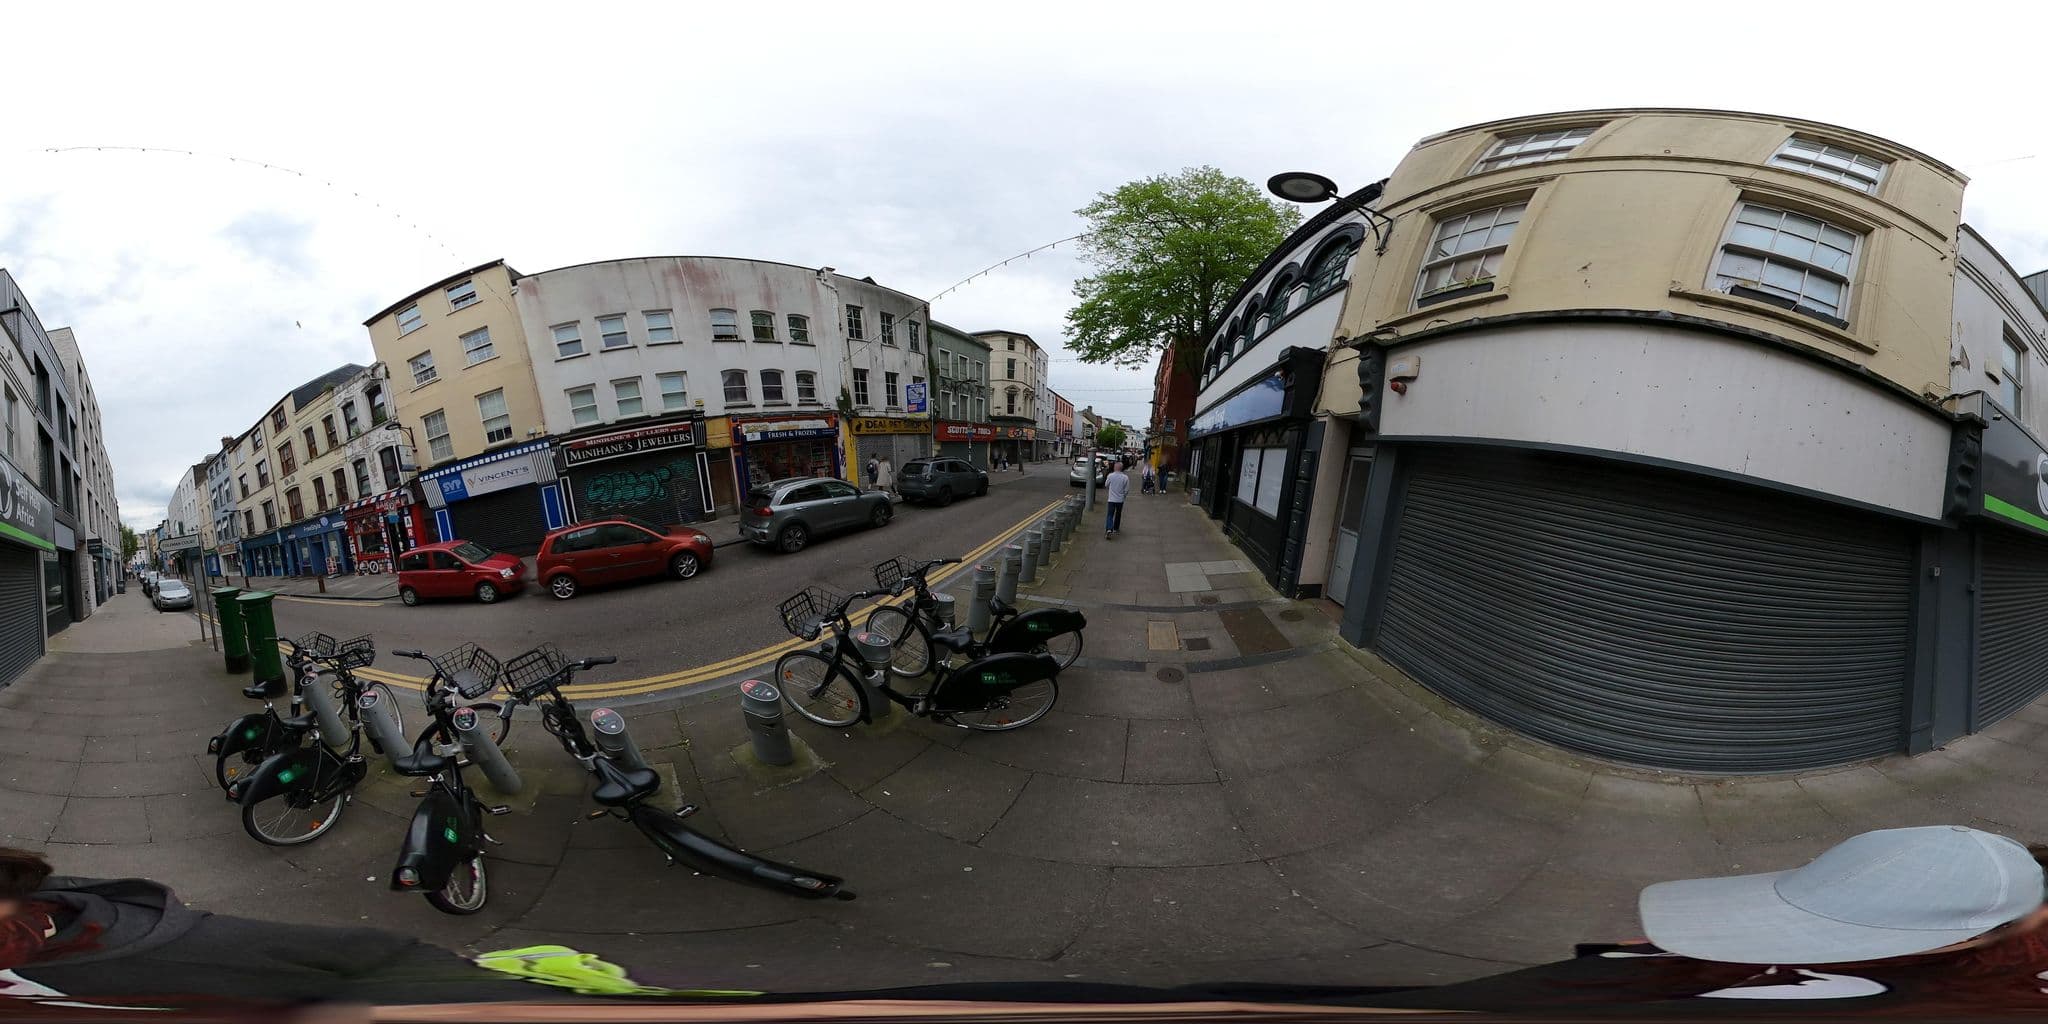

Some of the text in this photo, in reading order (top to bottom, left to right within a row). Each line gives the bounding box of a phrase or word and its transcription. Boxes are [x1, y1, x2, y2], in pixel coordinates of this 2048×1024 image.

[767, 431, 787, 439] FRESH
[570, 432, 691, 462] MINIHANE'S JEWELLERS
[478, 465, 530, 483] VINCENT'S
[442, 478, 462, 493] SVP
[15, 478, 42, 515] Self Help
[16, 504, 35, 528] Africa
